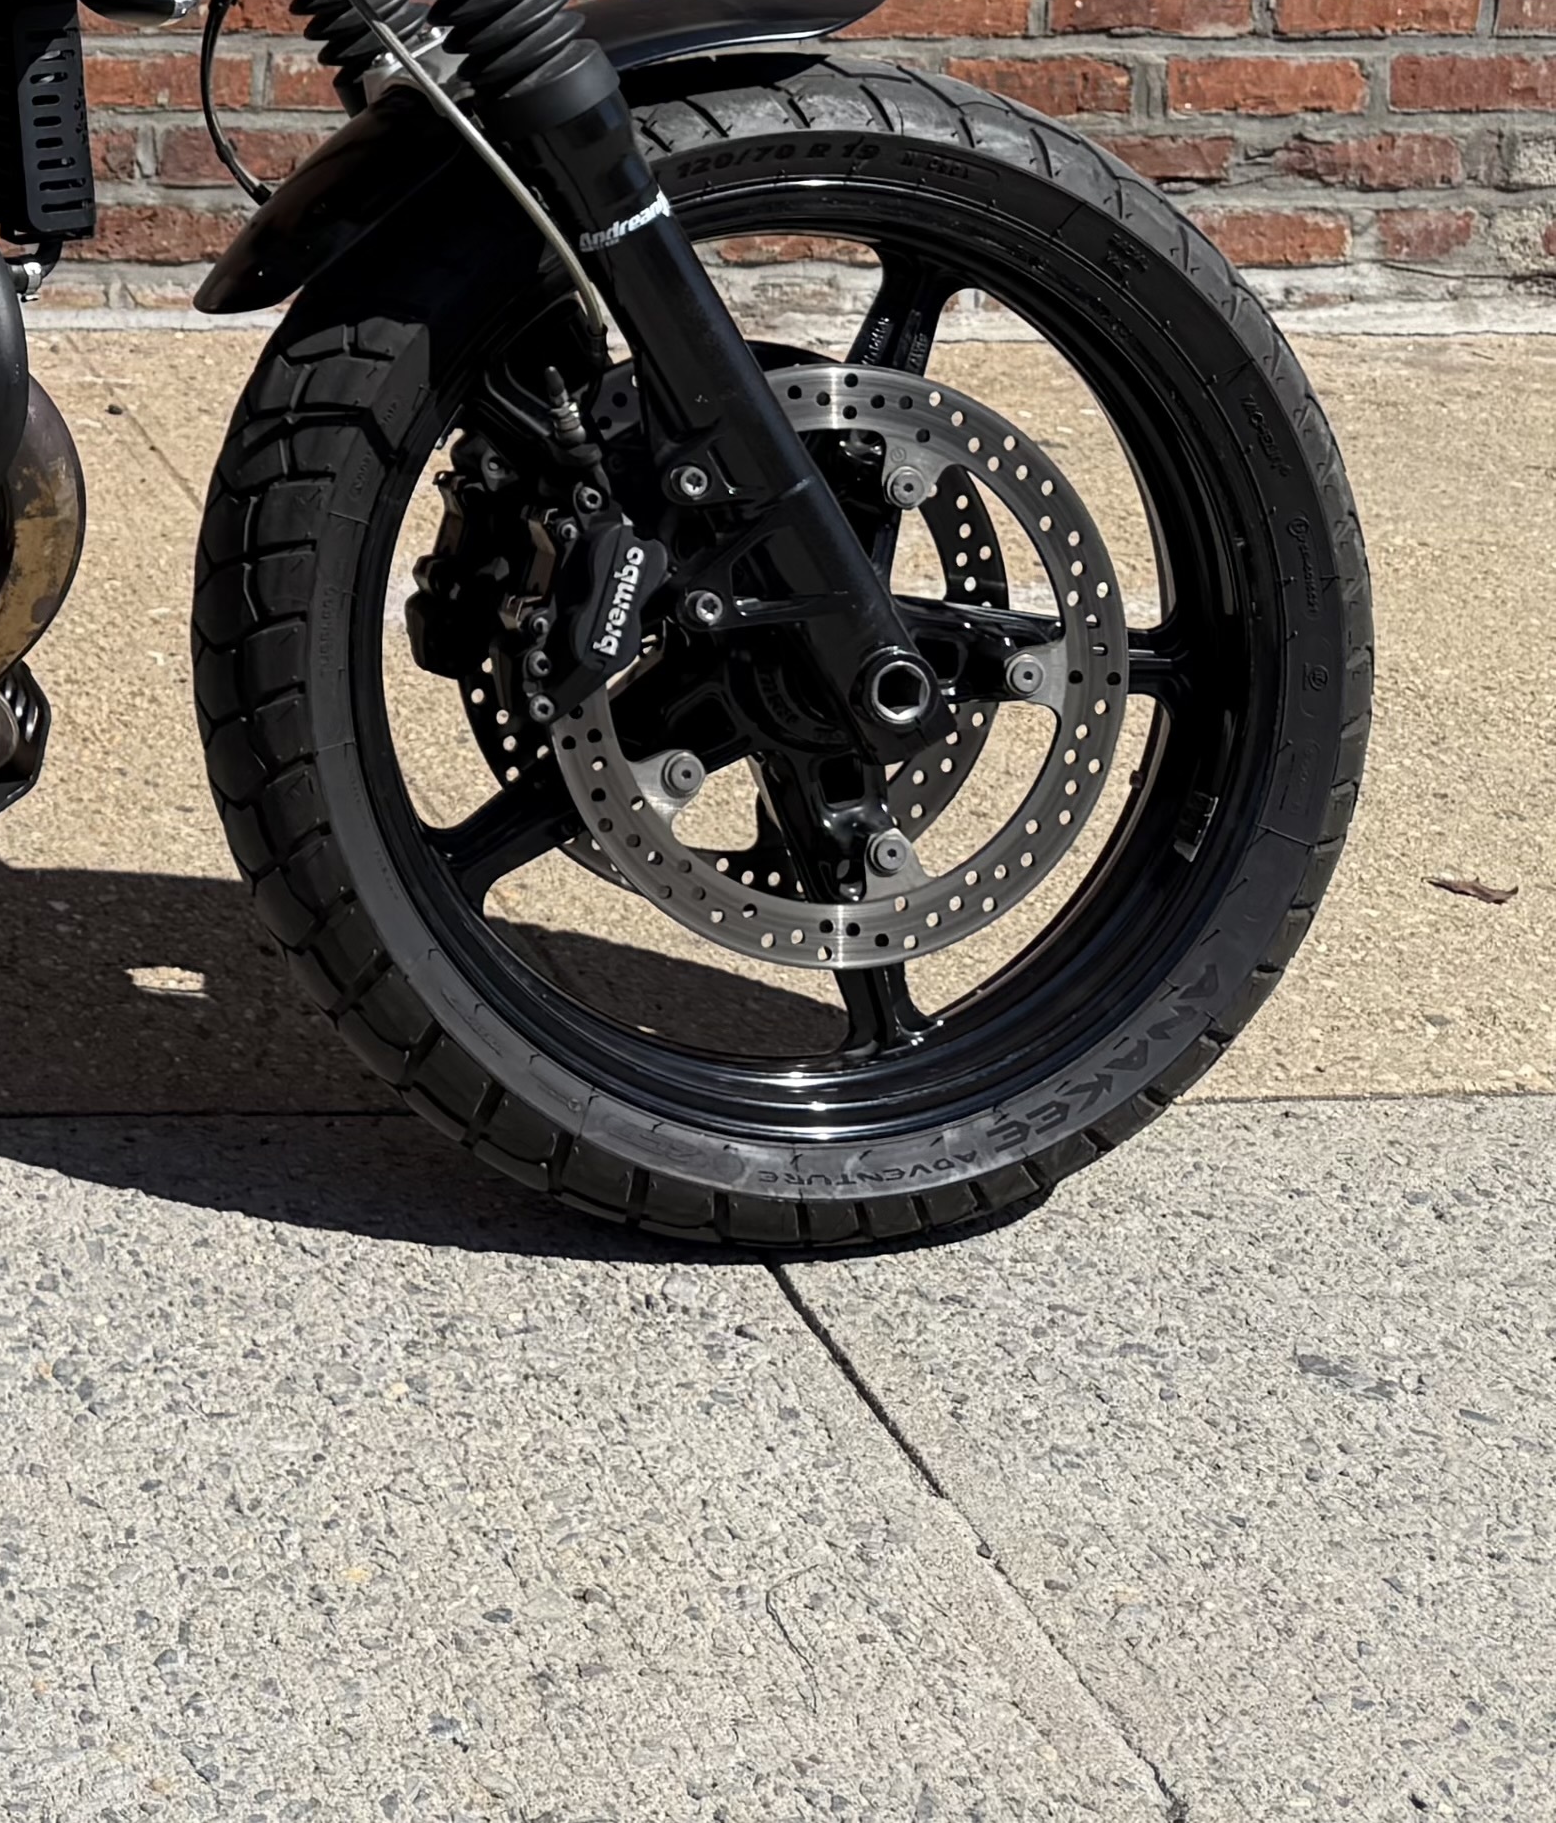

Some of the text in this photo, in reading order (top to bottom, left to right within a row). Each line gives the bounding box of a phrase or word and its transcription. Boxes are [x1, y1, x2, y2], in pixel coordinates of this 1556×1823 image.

[592, 545, 645, 656] brembo
[753, 958, 1231, 1189] ANAKEE ADVENTURE
